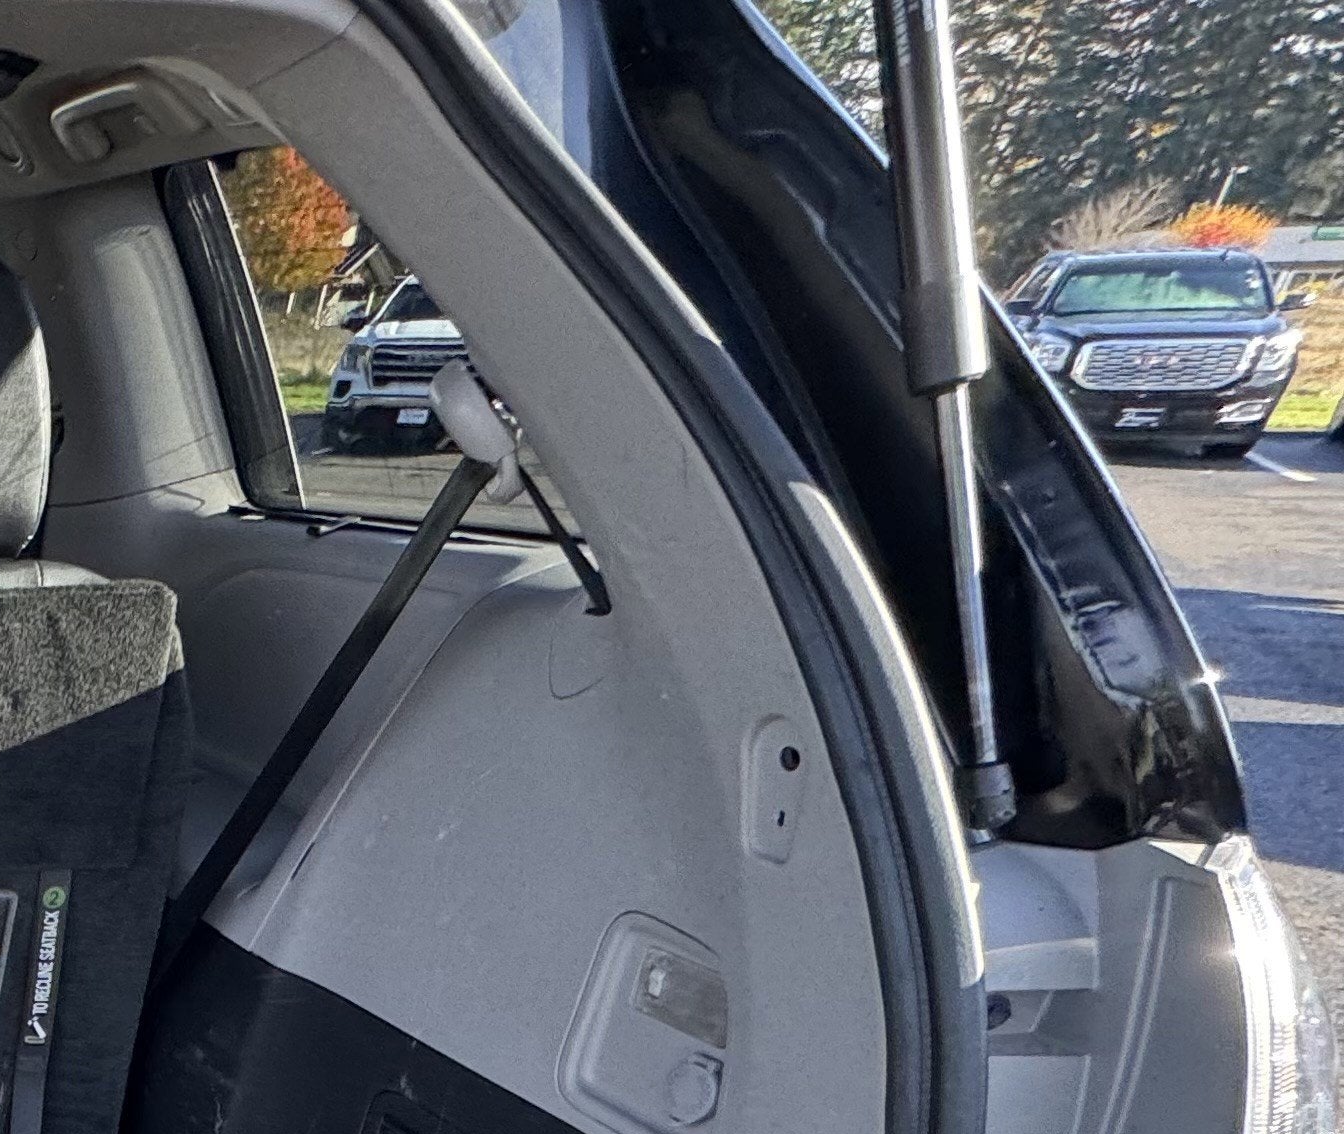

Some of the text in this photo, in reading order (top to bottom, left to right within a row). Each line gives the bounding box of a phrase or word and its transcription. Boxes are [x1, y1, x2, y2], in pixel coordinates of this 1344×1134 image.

[49, 889, 60, 906] 2
[32, 910, 60, 1015] TO RECLINE SEATBACK
